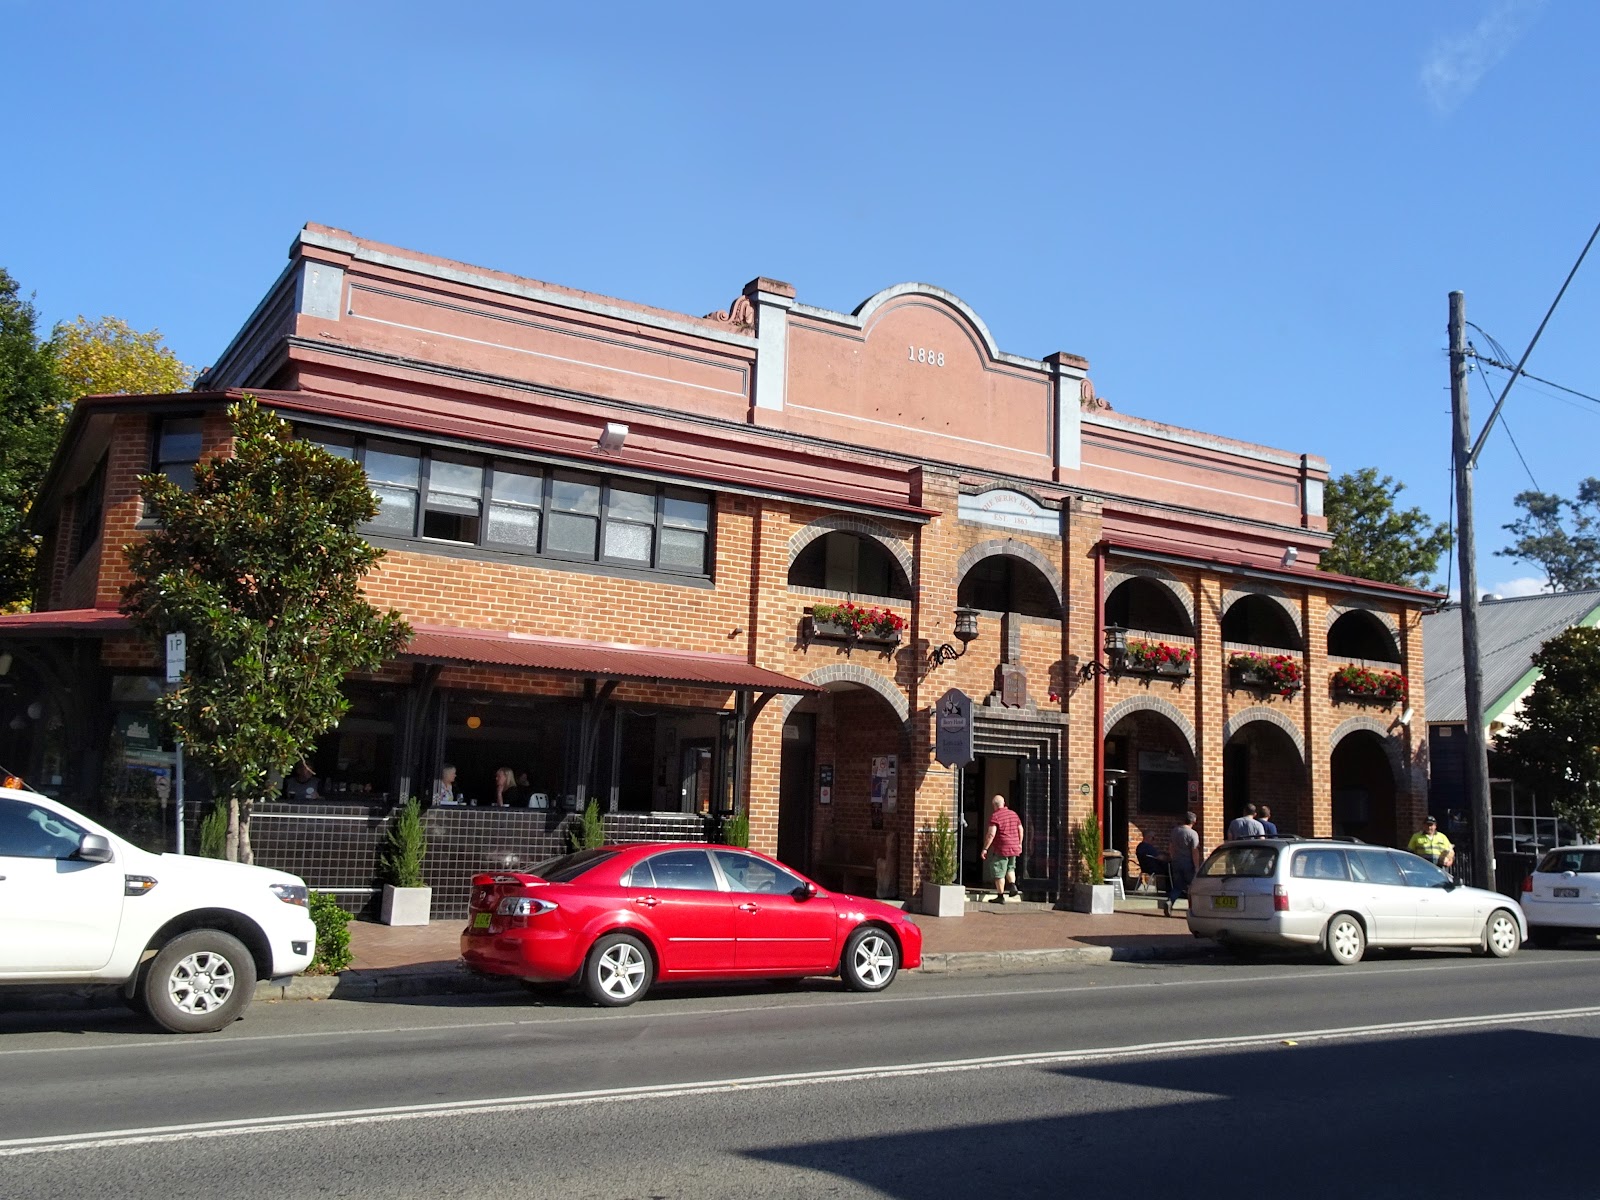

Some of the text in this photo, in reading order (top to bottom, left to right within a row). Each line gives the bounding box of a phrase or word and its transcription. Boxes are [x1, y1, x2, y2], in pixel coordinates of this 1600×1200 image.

[909, 346, 945, 367] 1888
[994, 494, 1018, 503] BERRY
[170, 639, 182, 651] 1P
